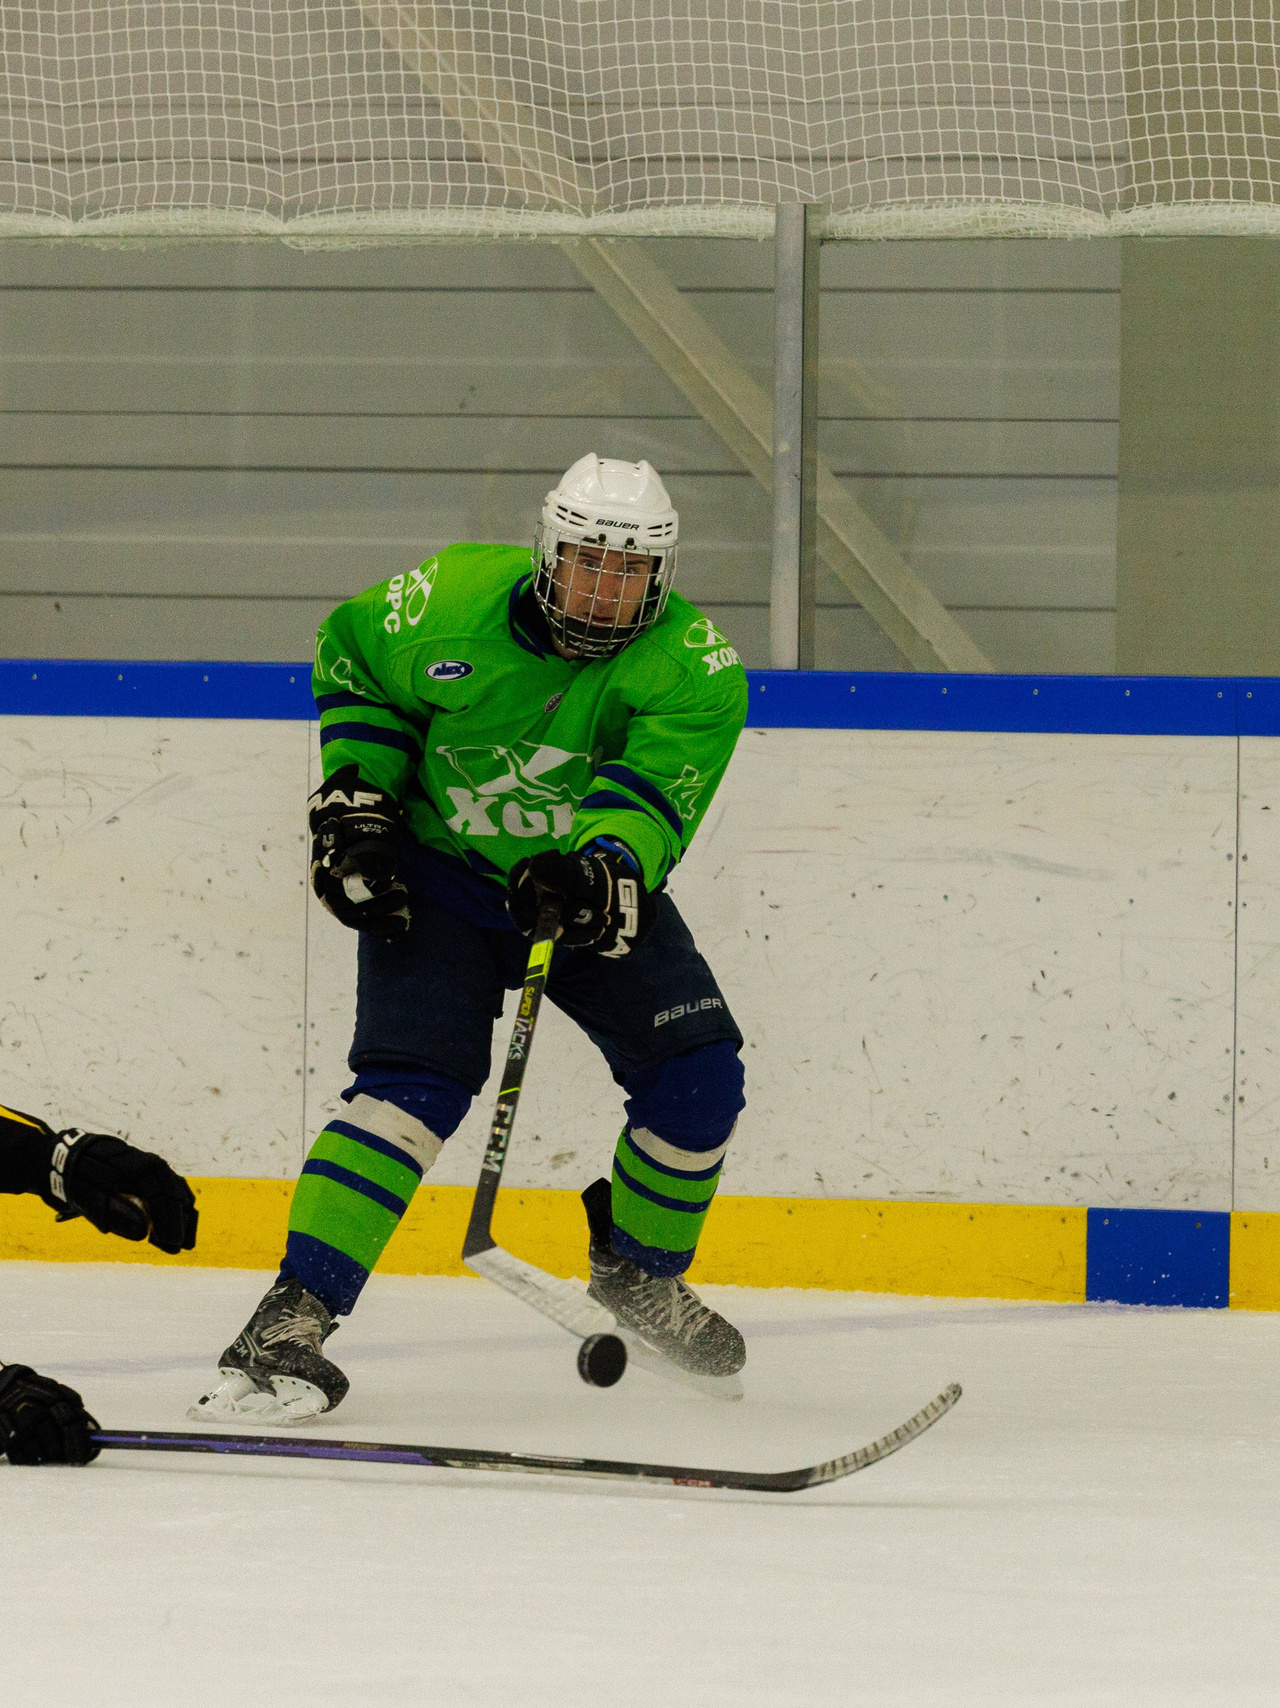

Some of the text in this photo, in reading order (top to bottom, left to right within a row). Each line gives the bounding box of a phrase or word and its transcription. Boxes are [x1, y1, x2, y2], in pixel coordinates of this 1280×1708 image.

[595, 518, 640, 531] BAUER
[701, 646, 743, 676] ХОР
[654, 998, 723, 1028] BAUER
